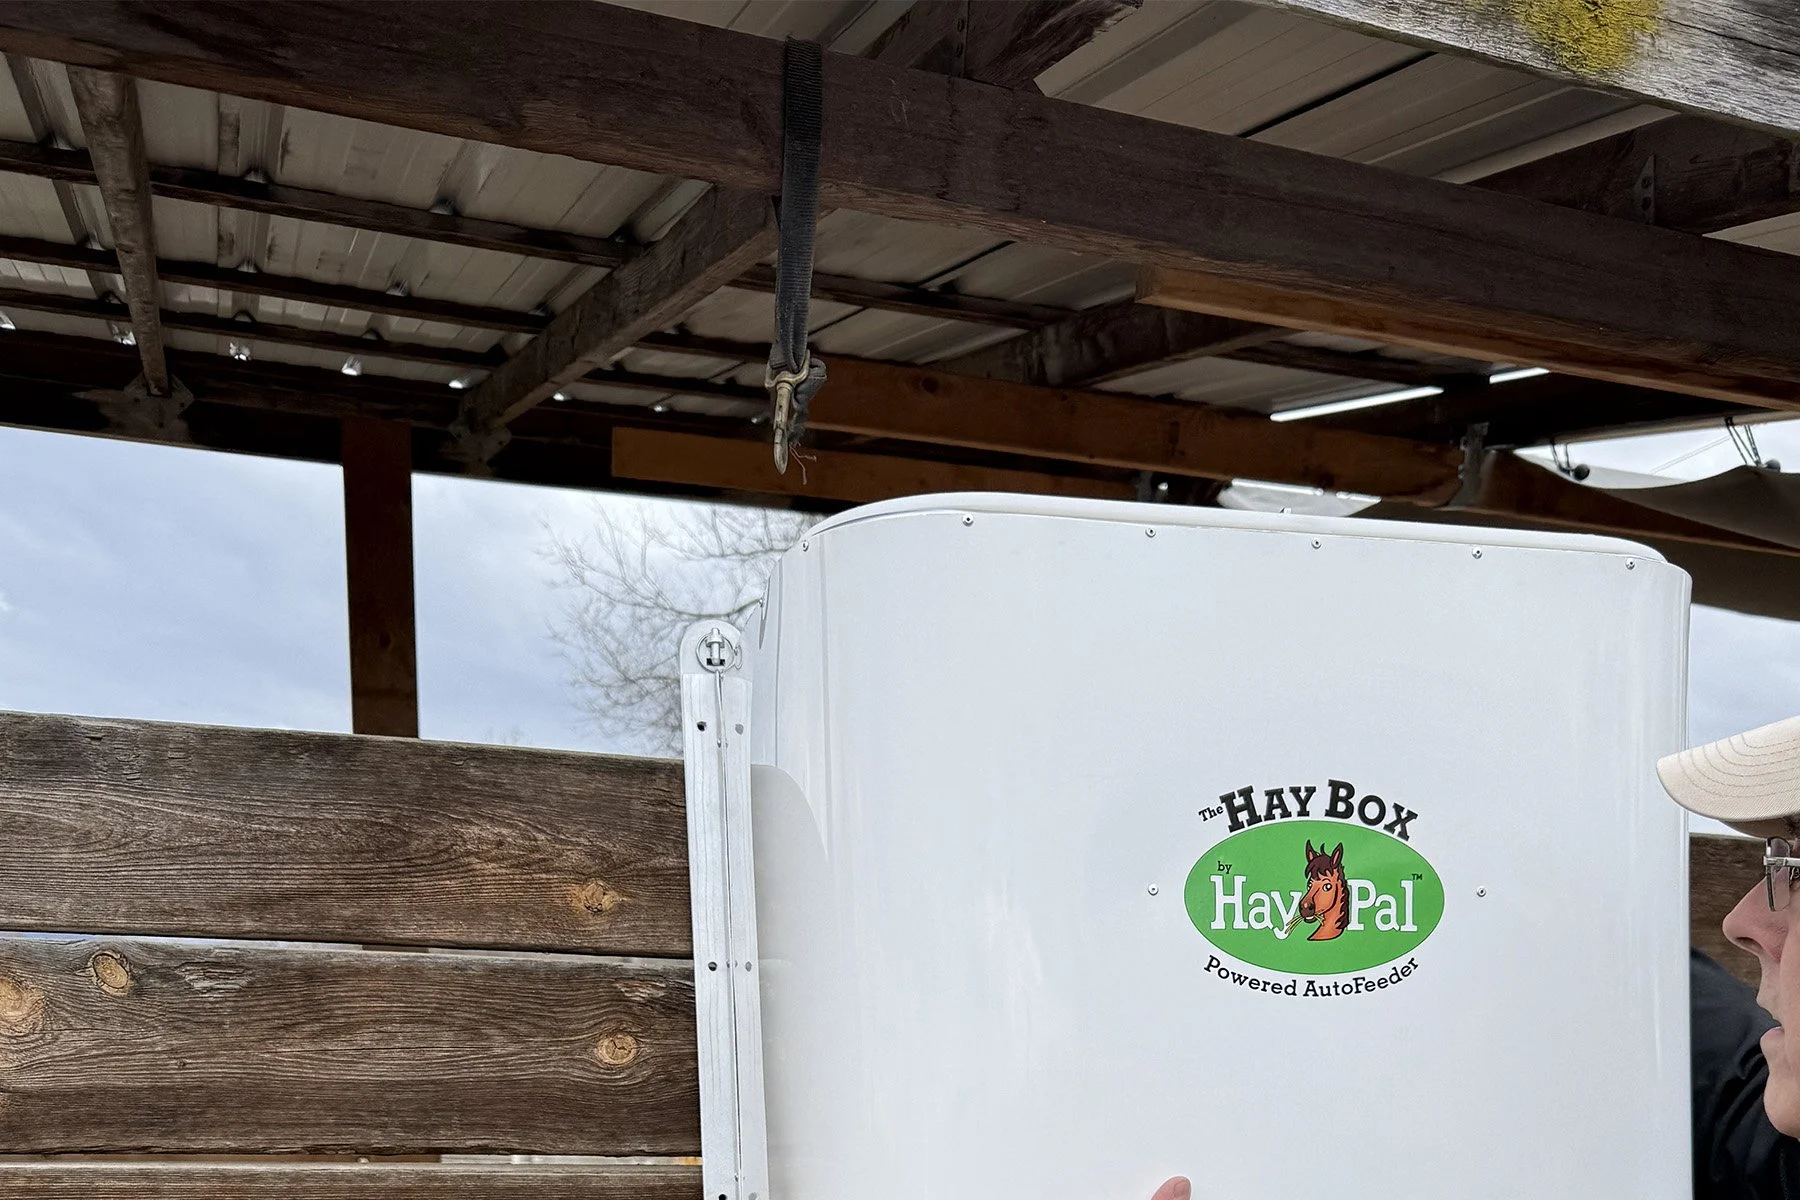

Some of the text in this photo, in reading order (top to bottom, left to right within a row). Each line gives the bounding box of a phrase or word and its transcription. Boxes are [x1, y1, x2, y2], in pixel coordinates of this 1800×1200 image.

[1198, 778, 1419, 842] The HAY BOX
[1217, 861, 1233, 874] by
[1209, 875, 1303, 940] Hay
[1347, 878, 1418, 933] Pal
[1203, 955, 1419, 998] Powered AutoFeeder
